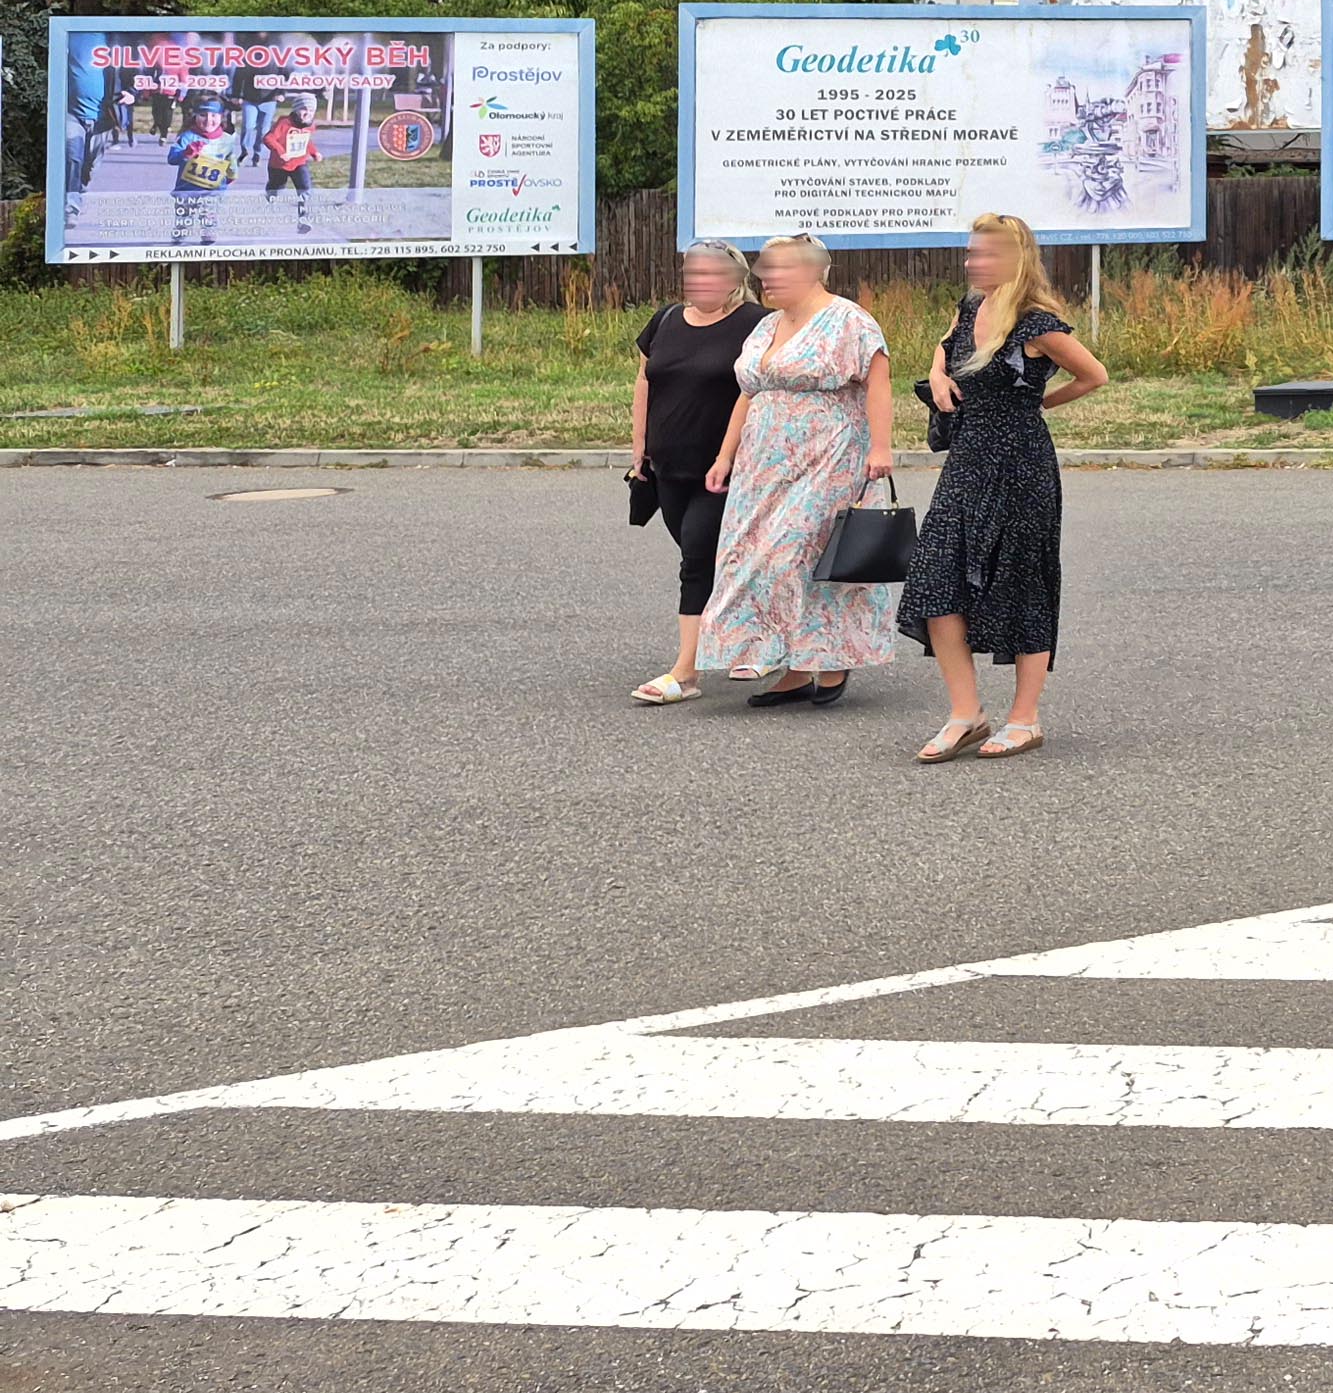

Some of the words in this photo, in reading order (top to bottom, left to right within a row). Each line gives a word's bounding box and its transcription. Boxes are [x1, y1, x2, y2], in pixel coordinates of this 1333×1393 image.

[480, 41, 495, 50] Za
[498, 42, 551, 51] podpory:
[776, 44, 937, 74] Geodetika
[960, 30, 980, 43] 30
[92, 41, 354, 68] SILVESTROVSKÝ
[366, 40, 429, 67] BĚH
[255, 75, 345, 87] KOLÁŘOVY
[351, 76, 395, 87] SADY
[472, 66, 562, 85] Prostějov
[187, 77, 227, 88] 2025
[817, 89, 859, 101] 1995
[874, 89, 917, 101] 2025
[488, 111, 546, 120] Olomoucký
[775, 109, 796, 121] 30
[801, 109, 829, 120] LET
[834, 106, 900, 121] POCTIVÉ
[905, 106, 957, 121] PRÁCE
[711, 130, 721, 141] V
[726, 127, 849, 141] ZEMĚMĚŘICTVÍ
[854, 129, 875, 141] NA
[880, 127, 948, 141] STŘEDNÍ
[953, 126, 1019, 140] MORAVĚ
[722, 158, 800, 168] GEOMETRICKÉ
[804, 157, 840, 168] PLÁNY,
[844, 157, 909, 167] VYTYČOVÁNÍ
[955, 156, 1007, 166] POZEMKŮ
[780, 177, 846, 187] VYTYČOVÁNÍ
[895, 178, 951, 186] PODKLADY
[774, 190, 797, 198] PRO
[800, 188, 851, 198] DIGITÁLNÍ
[854, 190, 922, 198] TECHNICKOU
[926, 189, 957, 197] MAPU
[466, 207, 552, 223] Geodetika
[775, 207, 819, 217] MAPOVÉ
[823, 209, 879, 217] PODKLADY
[468, 223, 551, 233] PROSTĚJOV
[798, 220, 813, 228] 3D
[816, 218, 870, 228] LASEROVÉ
[873, 218, 934, 227] SKENOVÁNÍ
[145, 248, 206, 258] REKLAMNÍ
[209, 248, 256, 257] PLOCHA
[259, 248, 266, 257] K
[270, 246, 337, 257] PRONÁJMU,
[341, 247, 368, 255] TEL.:
[371, 246, 390, 254] 728
[394, 245, 412, 254] 115
[440, 245, 461, 253] 602
[464, 244, 483, 253] 522
[486, 244, 506, 253] 750
